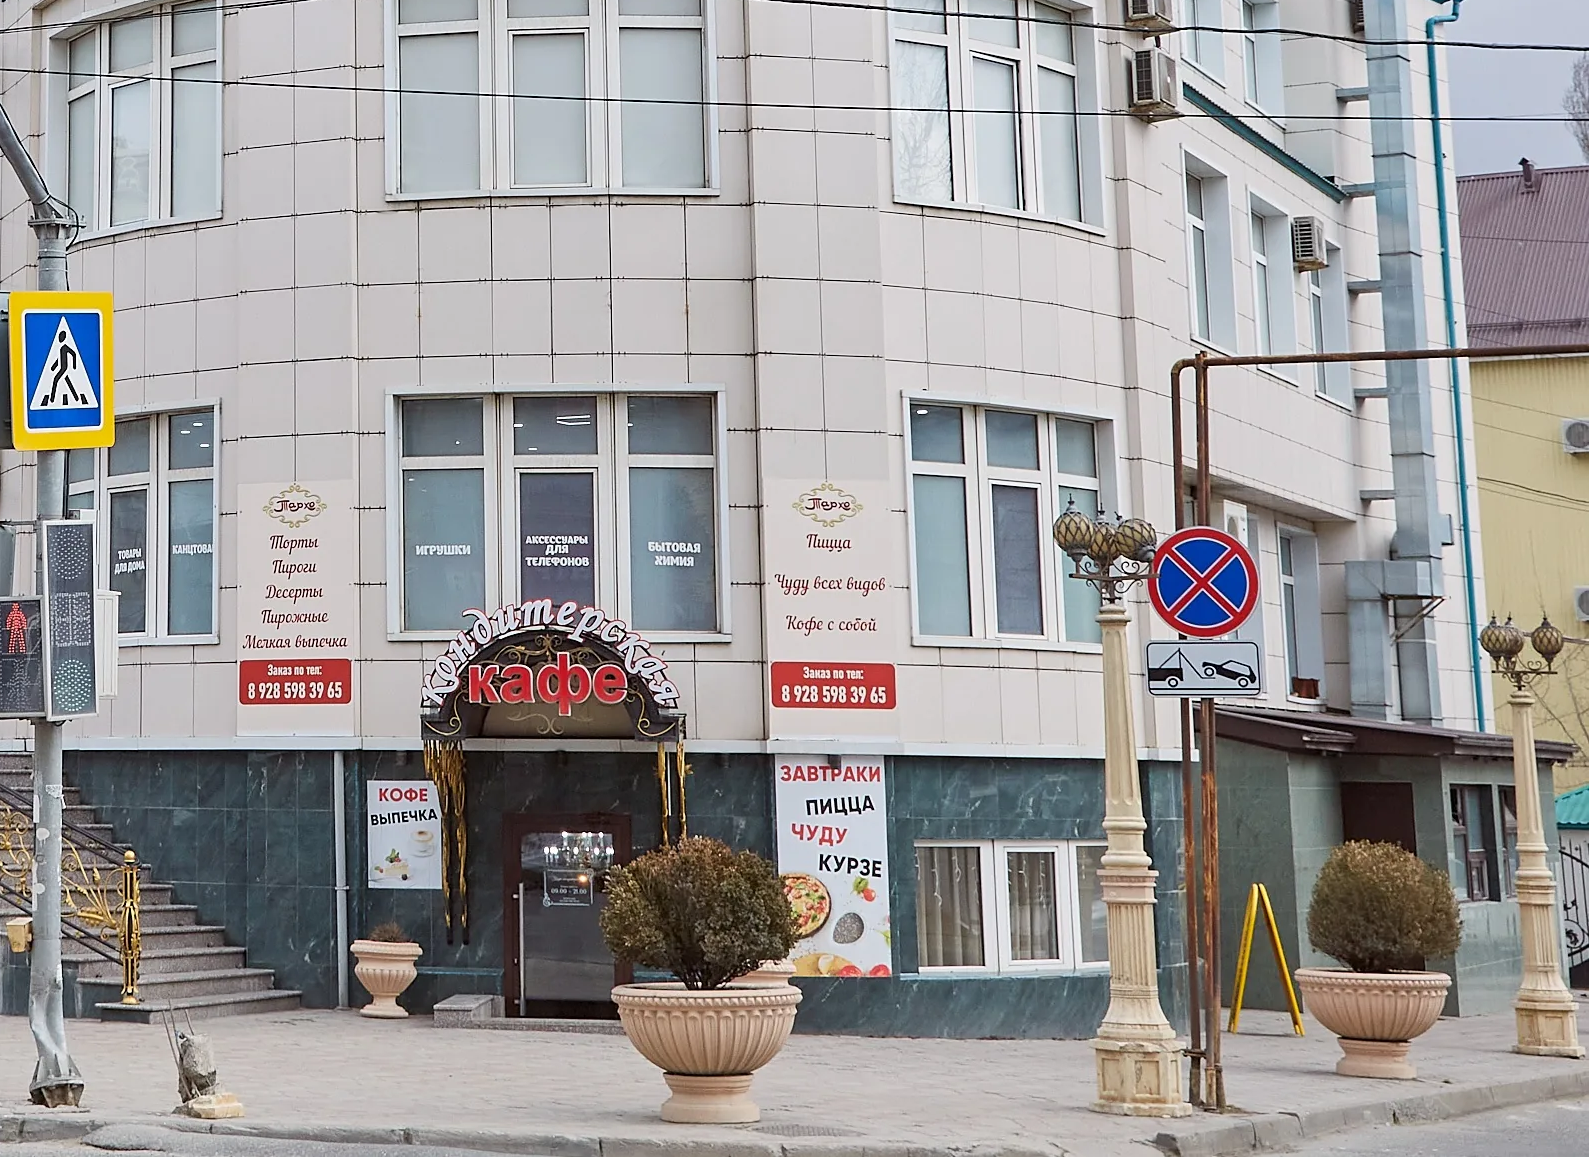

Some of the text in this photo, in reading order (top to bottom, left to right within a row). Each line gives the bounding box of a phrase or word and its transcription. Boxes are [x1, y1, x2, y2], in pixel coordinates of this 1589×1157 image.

[270, 535, 319, 555] Торты
[525, 535, 589, 544] АКСЕССУАРЫ
[647, 542, 701, 553] БЫТОВАЯ
[806, 534, 851, 552] Пицца
[117, 548, 142, 560] ТОВАРЫ
[172, 544, 214, 556] КАНЦТОВА
[415, 545, 471, 556] ИГРУШКИ
[545, 544, 569, 555] ДЛЯ
[114, 560, 145, 575] ДЛЯ ДОМА
[525, 556, 590, 567] ТЕЛЕФОНОВ
[655, 555, 694, 567] ХИМИЯ
[272, 560, 317, 580] Пироги
[774, 574, 886, 597] Чуду всех видов
[265, 585, 323, 604] Десерты
[261, 609, 329, 630] Пирожные
[786, 615, 877, 636] Кофе с собой
[242, 634, 348, 649] Мелкая выпечка
[422, 598, 680, 708] Кондитерская
[267, 664, 322, 676] Заказ по тел:
[803, 667, 864, 680] Заказ по тел:
[248, 682, 342, 699] 8 928 598 39 65
[468, 651, 628, 716] кафе
[781, 685, 887, 704] 8 928 598 39 65
[780, 765, 881, 782] ЗАВТРАКИ
[379, 788, 428, 802] КОФЕ
[806, 795, 875, 816] ПИЦЦА
[371, 808, 438, 826] ВЫПЕЧКА
[791, 823, 848, 847] ЧУДУ
[818, 853, 882, 878] КУРЗЕ
